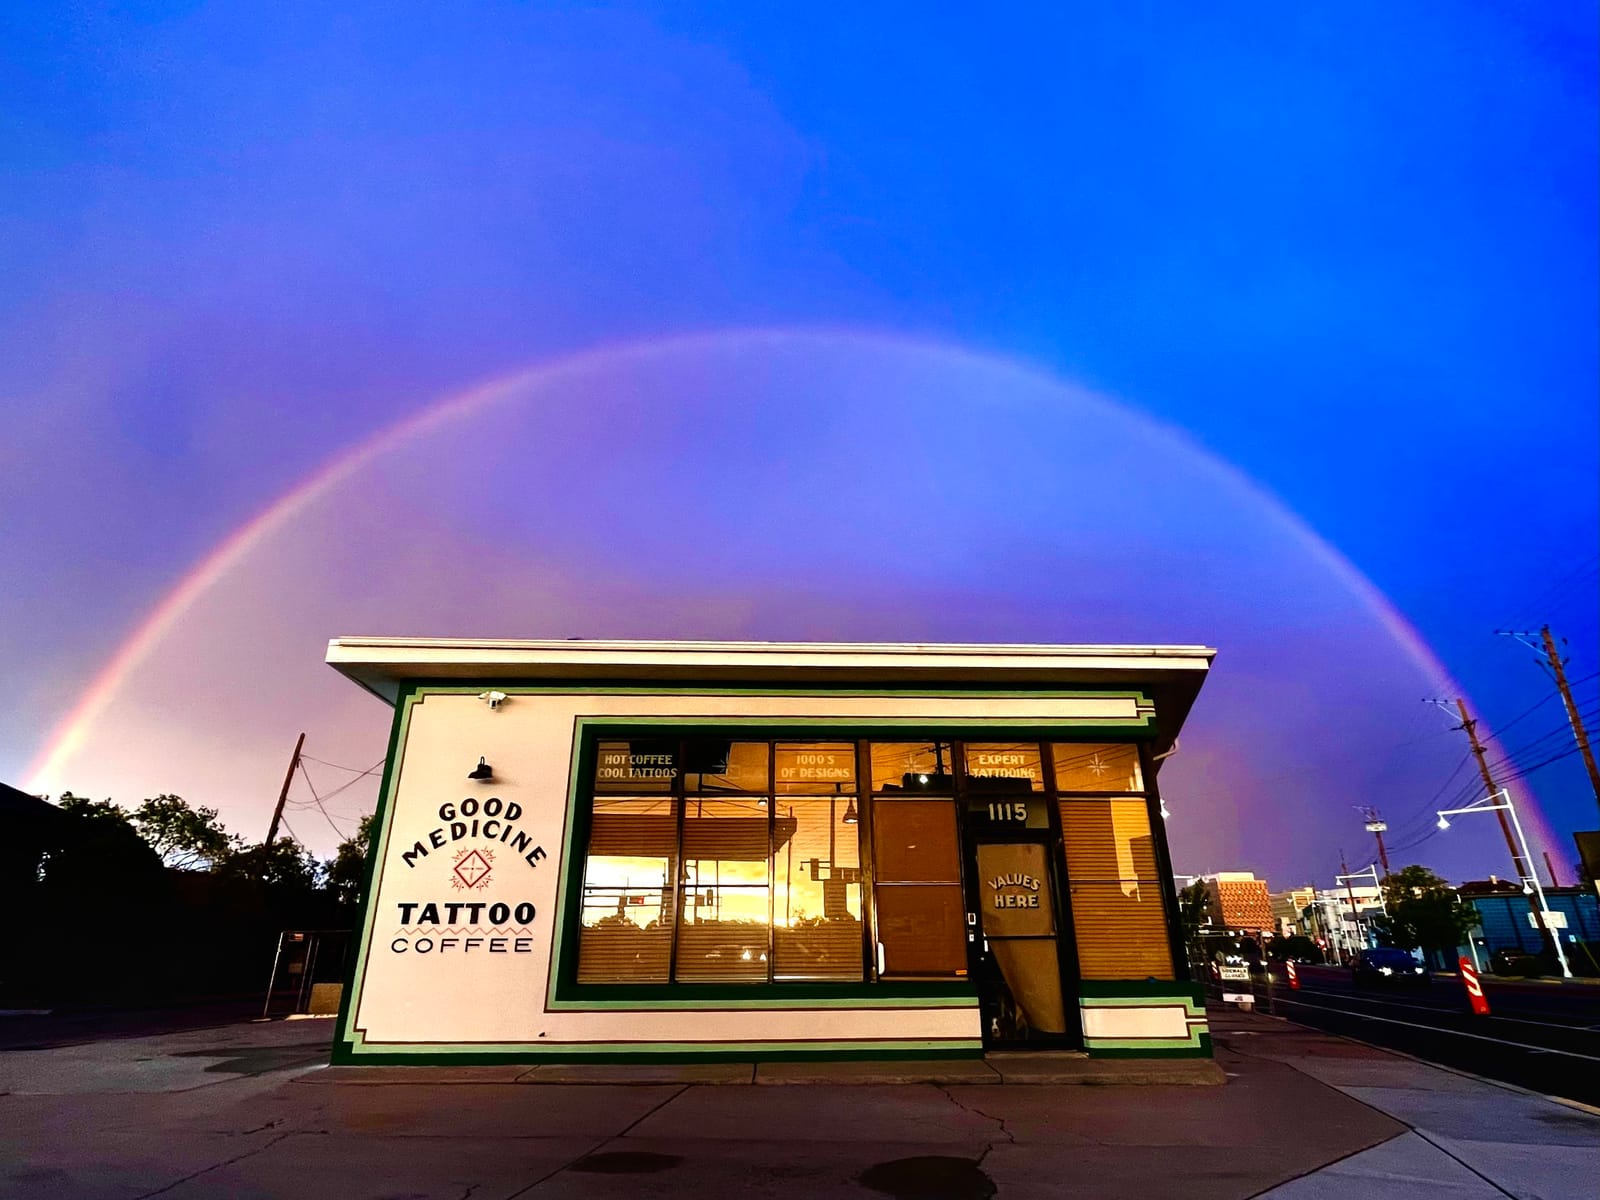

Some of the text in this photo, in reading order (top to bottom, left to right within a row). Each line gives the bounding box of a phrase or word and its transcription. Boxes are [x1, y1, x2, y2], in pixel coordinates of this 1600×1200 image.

[604, 754, 673, 765] HOT COFFEE
[978, 754, 1025, 765] EXPERT
[598, 767, 679, 778] COOL TATTOOS
[781, 767, 850, 778] OF DESIGNS
[972, 767, 1036, 778] TATTOOING
[439, 797, 523, 821] GOOD
[988, 802, 1028, 821] 1115
[401, 819, 547, 868] MEDICINE
[988, 873, 1041, 891] VALUES
[994, 895, 1040, 909] HERE
[398, 902, 536, 925] TATTOO
[391, 937, 534, 954] COFFEE
